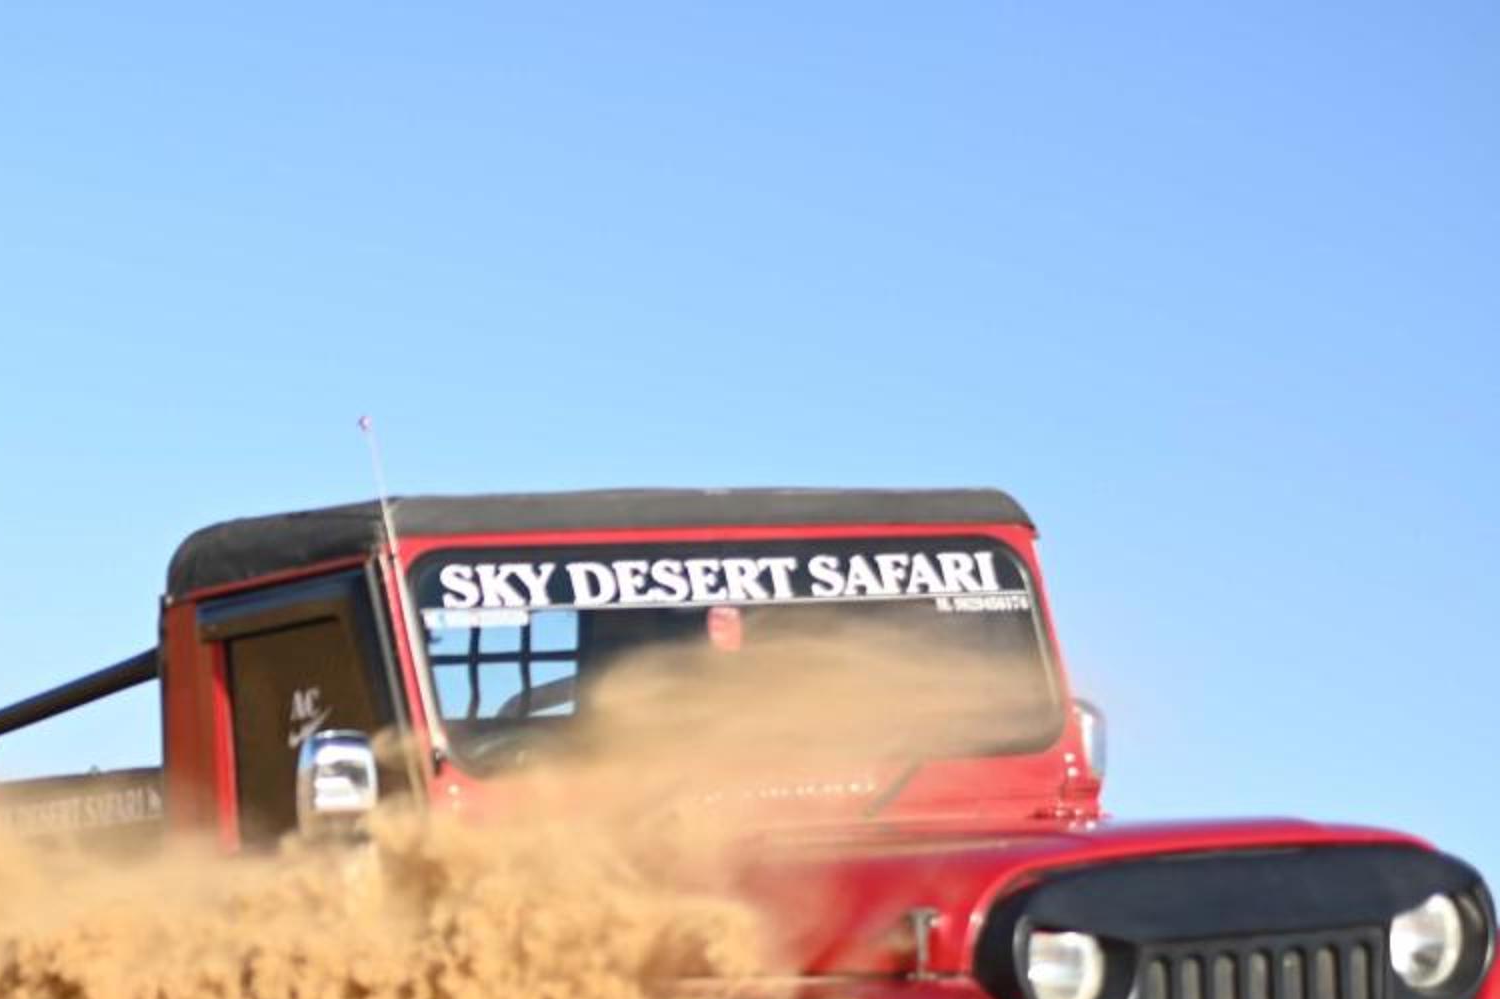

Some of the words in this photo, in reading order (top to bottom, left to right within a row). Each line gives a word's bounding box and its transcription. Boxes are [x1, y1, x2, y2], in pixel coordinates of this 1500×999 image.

[439, 562, 555, 608] SKY
[565, 557, 797, 606] DESERT
[807, 551, 999, 597] SAFARI
